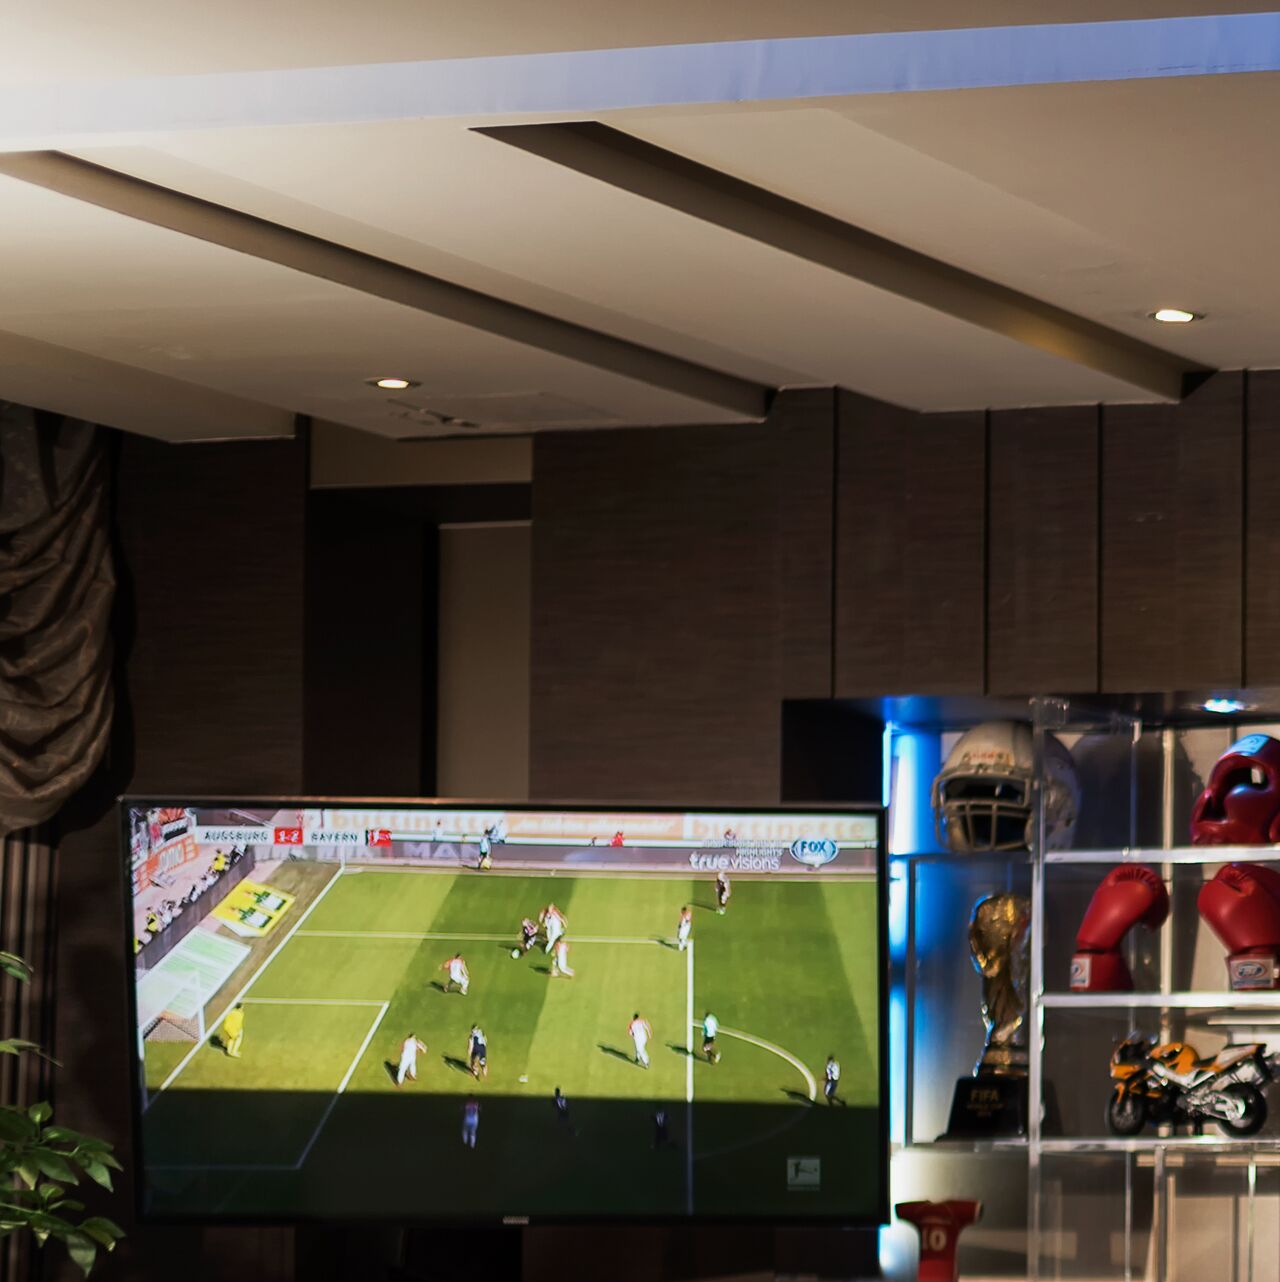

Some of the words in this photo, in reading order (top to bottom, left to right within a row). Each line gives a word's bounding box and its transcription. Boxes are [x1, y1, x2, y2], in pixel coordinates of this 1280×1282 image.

[204, 831, 269, 842] AUGSBURG
[311, 832, 358, 843] BAYERN
[800, 840, 827, 853] FOX
[689, 851, 730, 870] true
[731, 855, 781, 871] visions
[921, 1229, 947, 1251] 10
